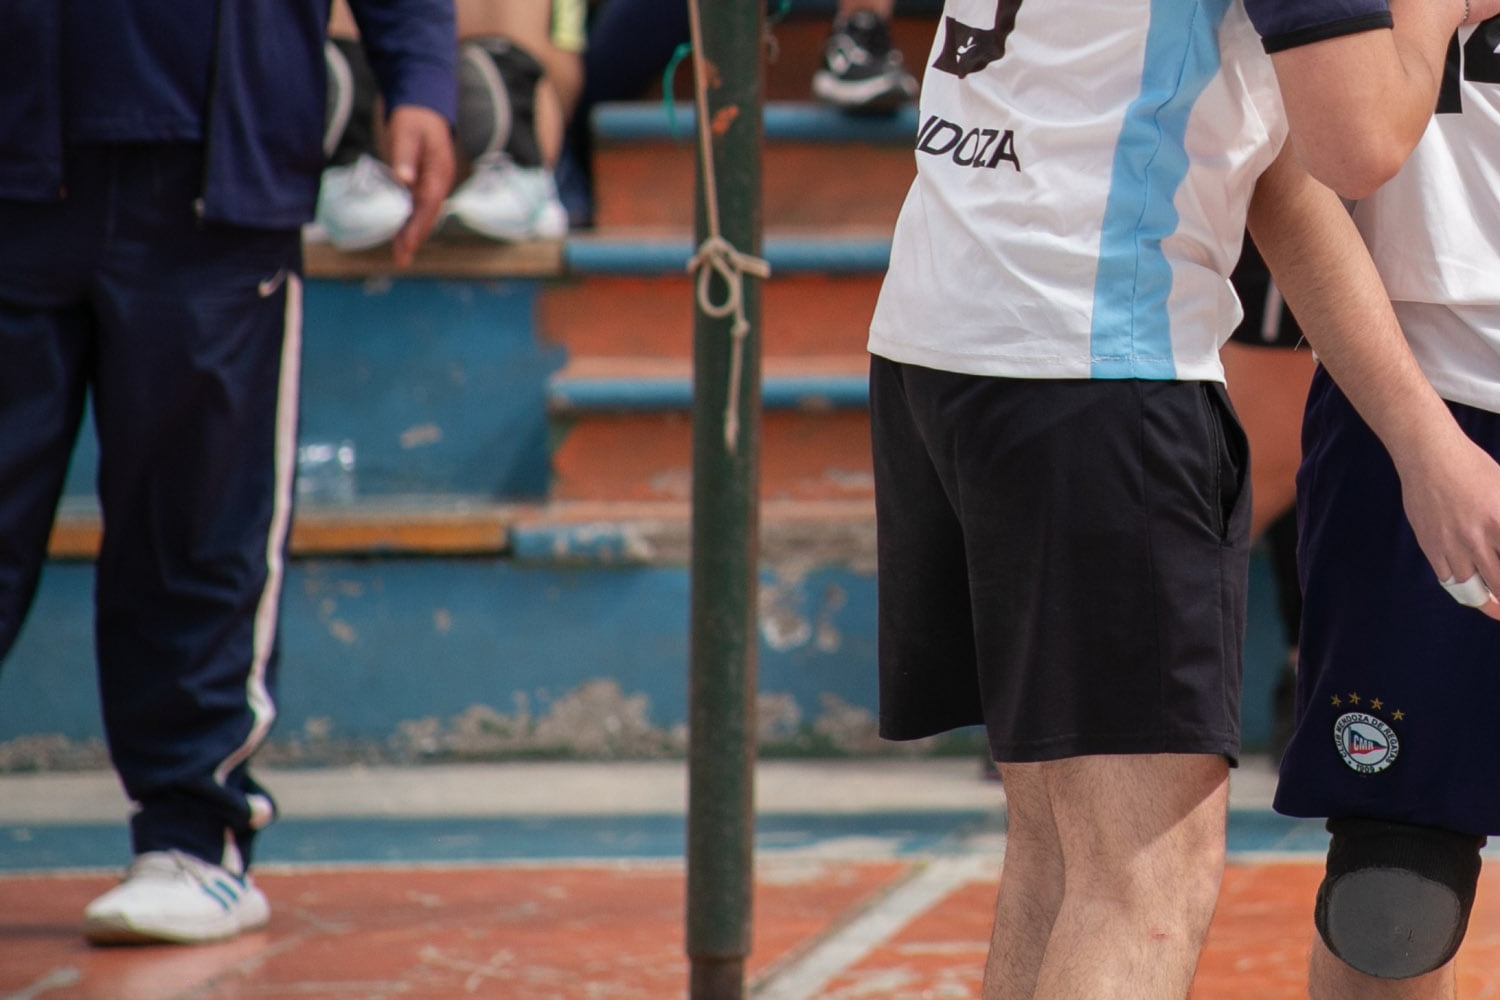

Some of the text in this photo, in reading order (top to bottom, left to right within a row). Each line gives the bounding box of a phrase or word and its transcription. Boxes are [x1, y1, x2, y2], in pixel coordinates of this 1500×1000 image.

[1335, 714, 1398, 763] CLUB MENDOZA DE REGATAS
